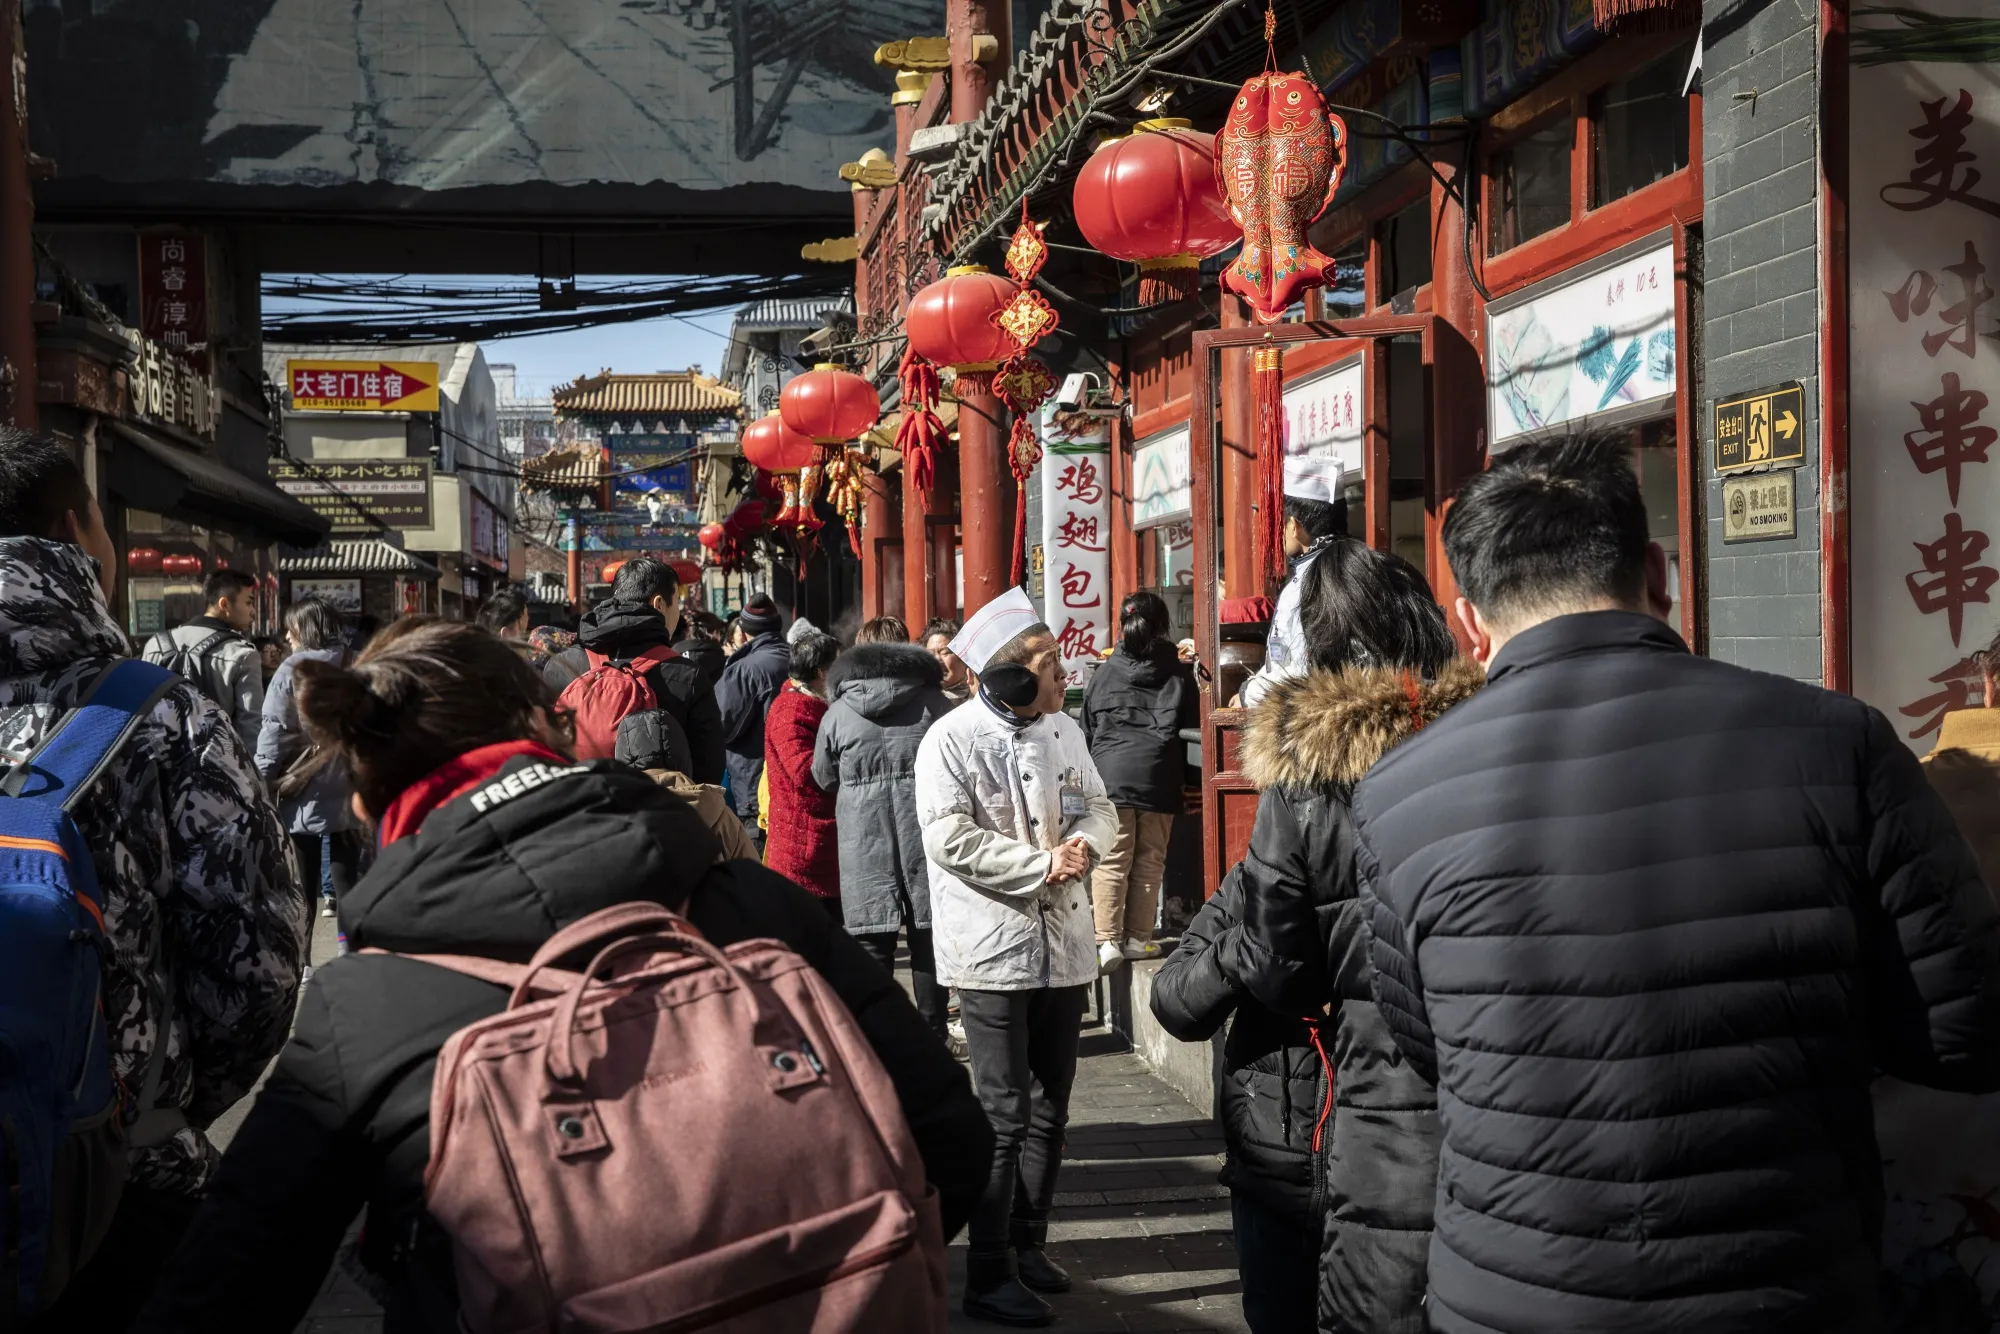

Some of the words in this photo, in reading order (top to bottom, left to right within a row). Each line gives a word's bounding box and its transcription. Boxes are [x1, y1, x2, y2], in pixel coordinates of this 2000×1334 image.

[295, 371, 403, 398] 大宅门住宿
[1719, 416, 1743, 439] 安全出口
[1723, 442, 1739, 456] EXIT
[1749, 485, 1788, 511] 禁止吸烟
[1749, 515, 1759, 526] NO
[1759, 512, 1788, 525] SMOKING
[1055, 456, 1106, 660] 鸡翅包饭
